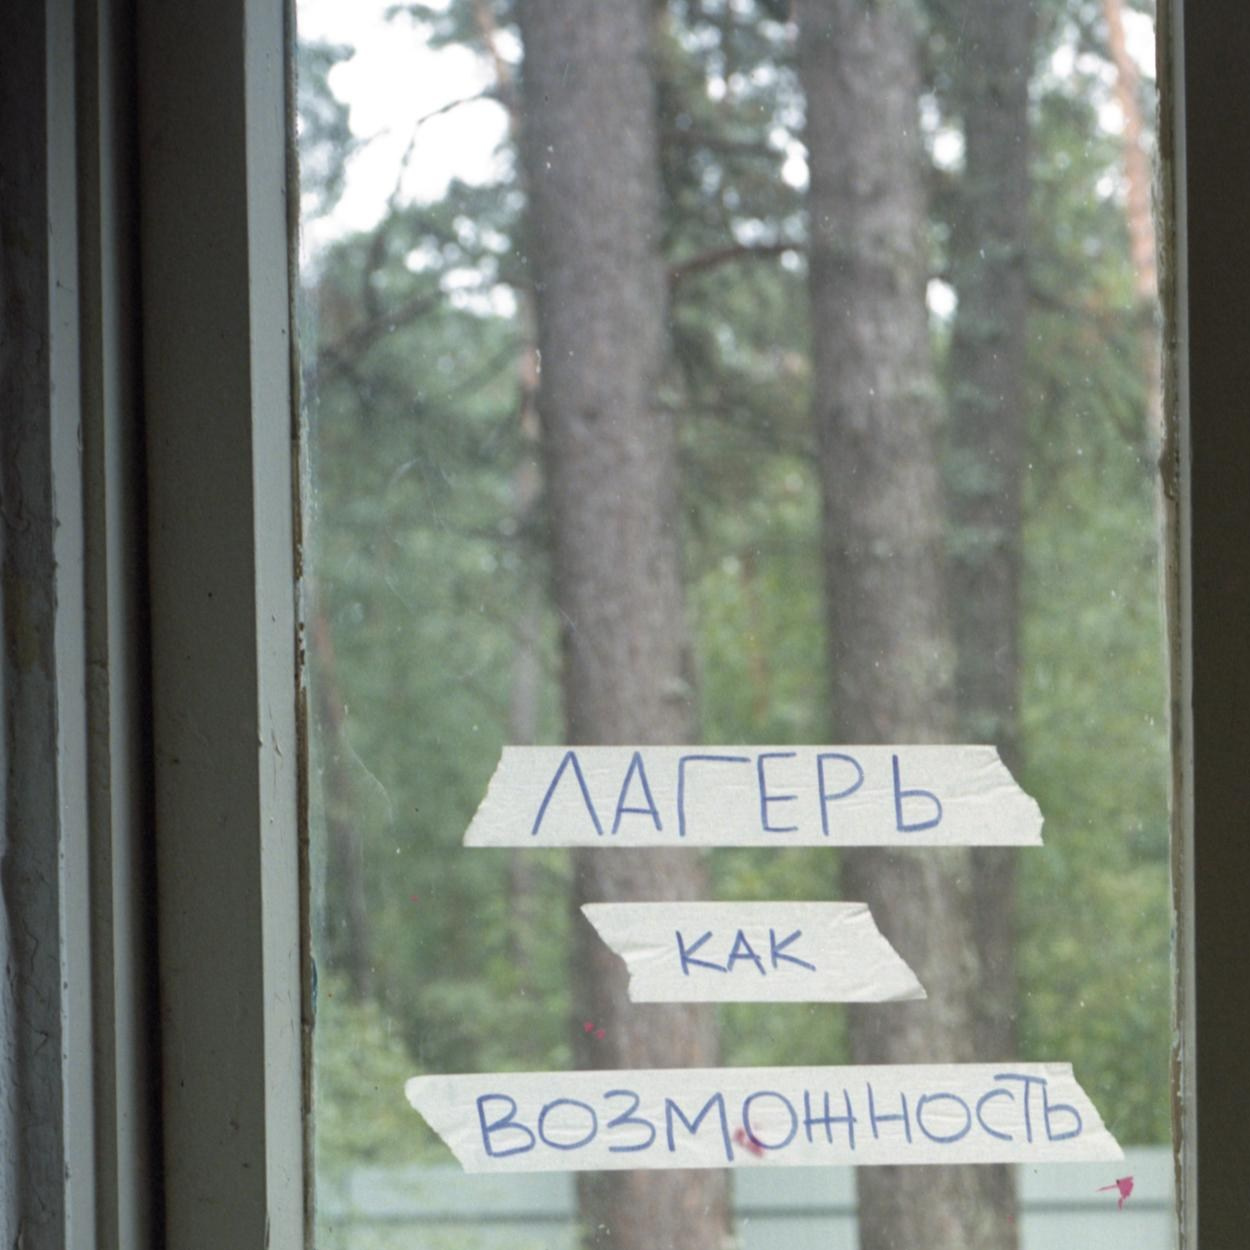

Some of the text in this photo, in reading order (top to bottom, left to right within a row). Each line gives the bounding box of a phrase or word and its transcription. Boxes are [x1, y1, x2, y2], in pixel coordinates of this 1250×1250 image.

[531, 751, 944, 837] ЛАГЕРЬ
[675, 928, 817, 976] КАК
[475, 1073, 1083, 1162] ВОЗМОЖНОСТЬ
